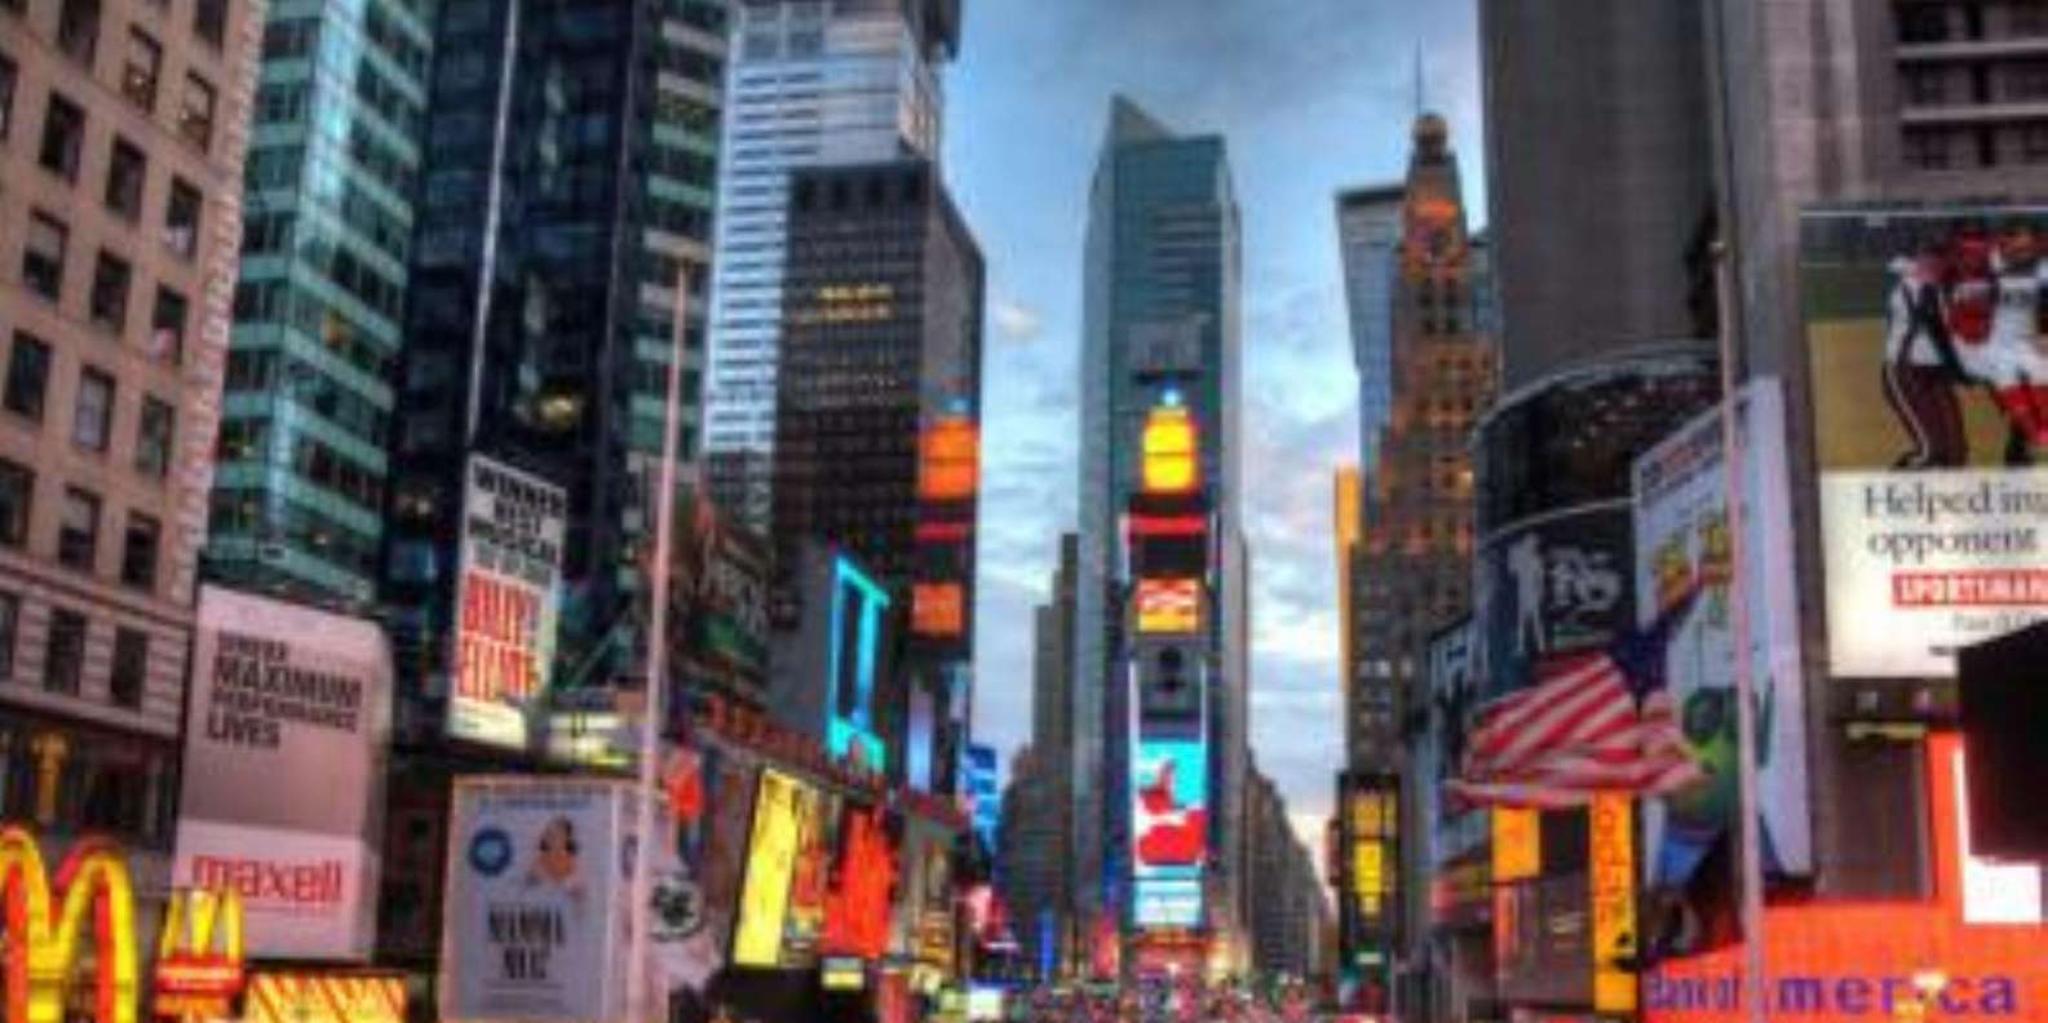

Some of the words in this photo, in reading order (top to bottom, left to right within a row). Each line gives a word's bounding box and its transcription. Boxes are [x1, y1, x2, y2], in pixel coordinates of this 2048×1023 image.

[1865, 481, 1993, 523] Helped
[1867, 527, 2036, 563] opponent
[213, 655, 363, 708] MAXIMUM
[207, 710, 281, 748] LIVES
[192, 856, 343, 903] maxell
[1766, 977, 2016, 1015] merca
